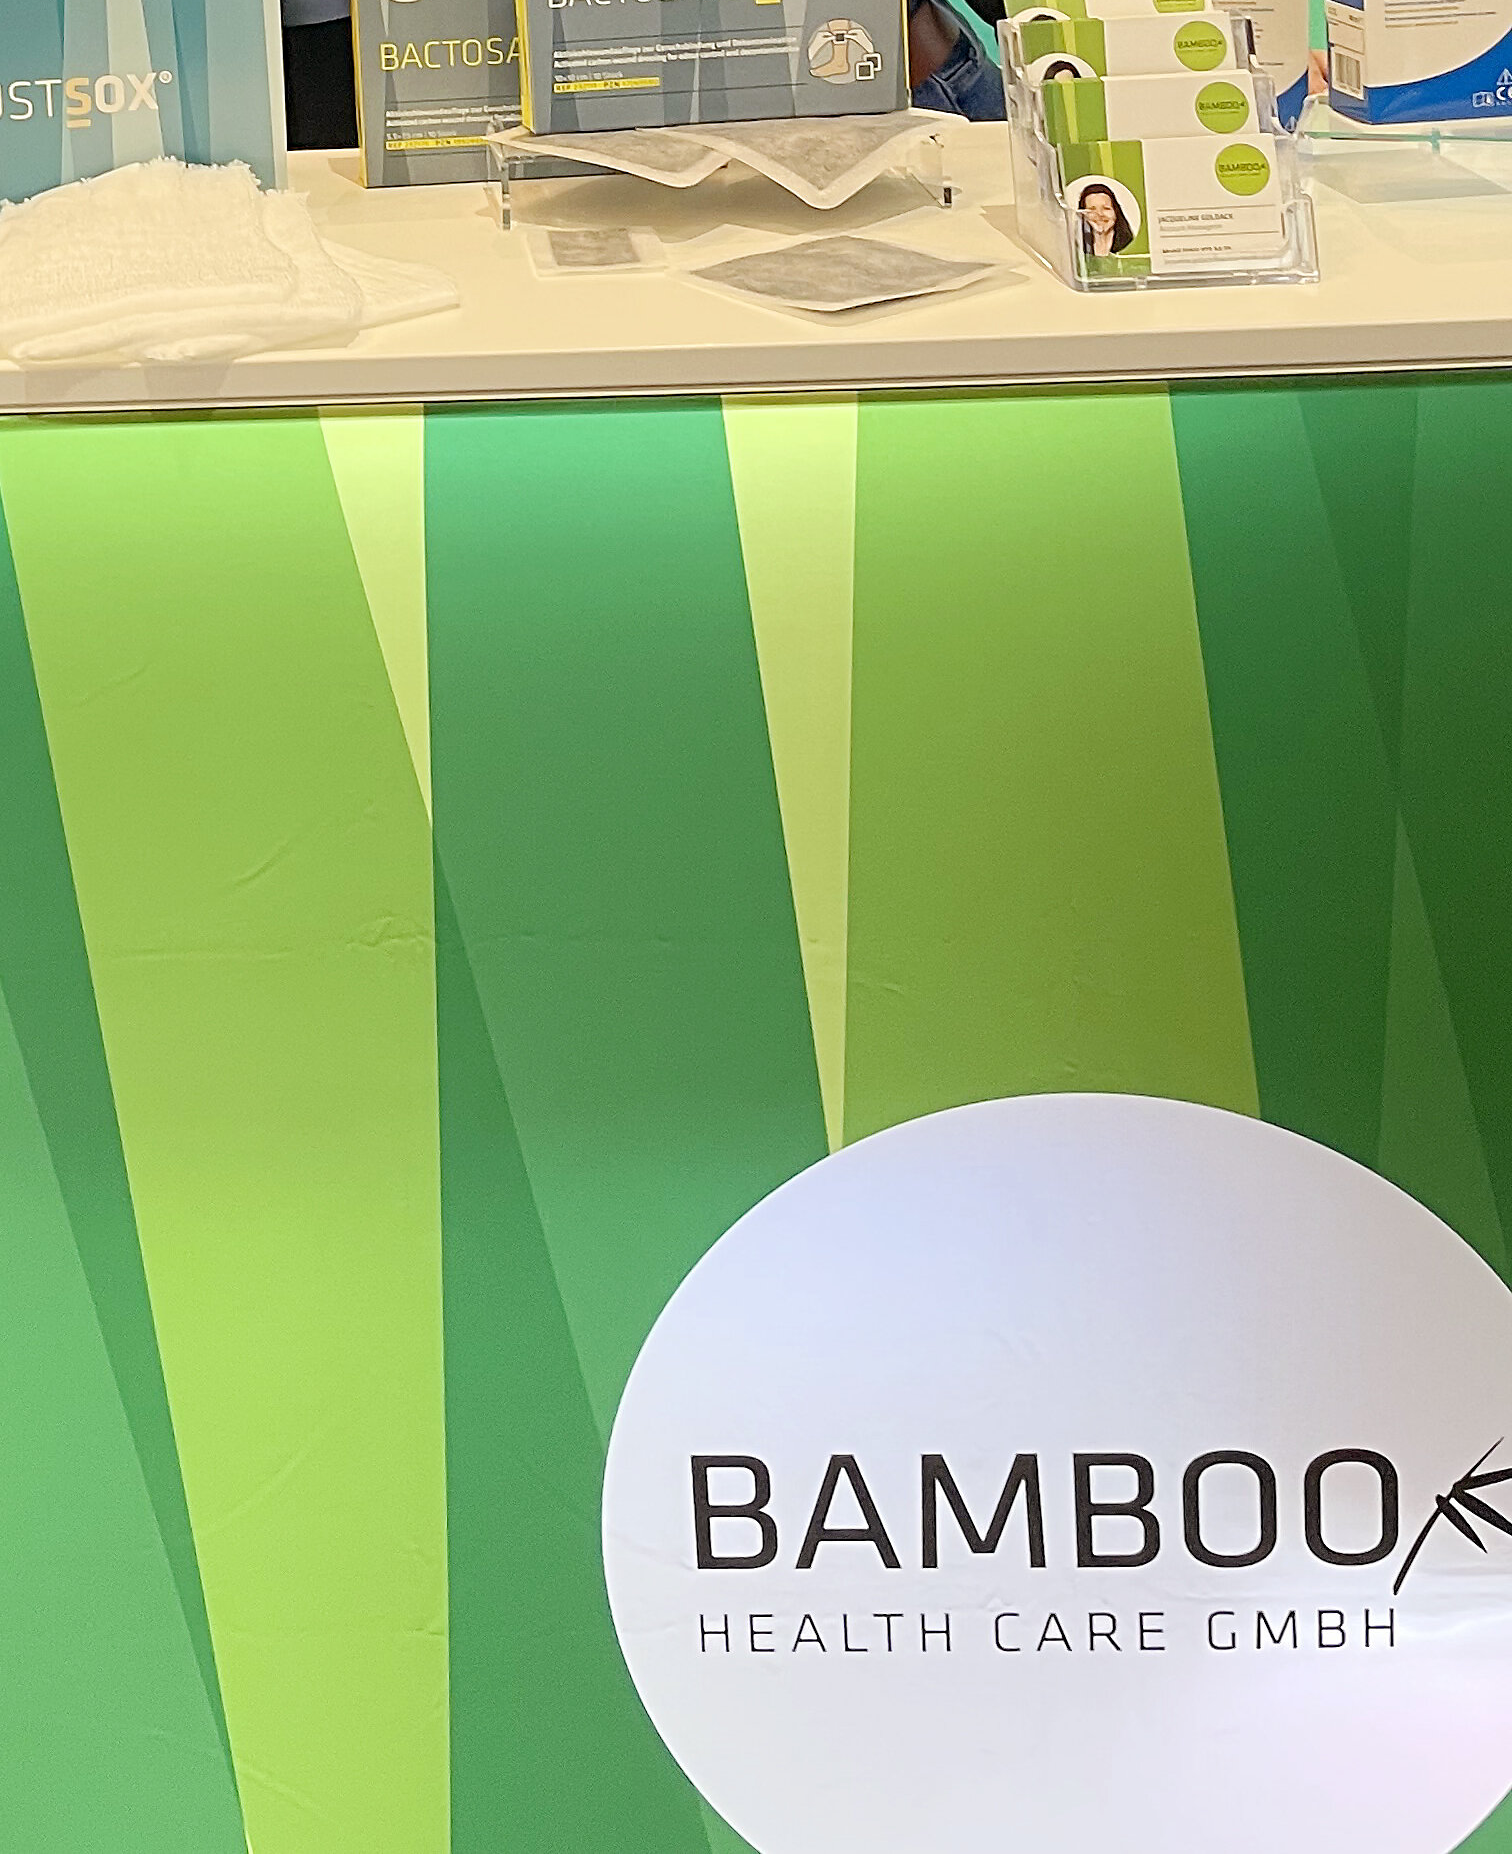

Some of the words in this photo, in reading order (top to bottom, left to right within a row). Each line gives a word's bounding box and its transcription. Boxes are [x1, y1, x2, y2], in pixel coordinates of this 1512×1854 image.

[379, 36, 521, 72] BACTOSA
[688, 1447, 1400, 1572] BAMBOO
[698, 1612, 954, 1654] HEALTH
[994, 1610, 1168, 1654] CARE
[1208, 1606, 1397, 1651] GMBH
